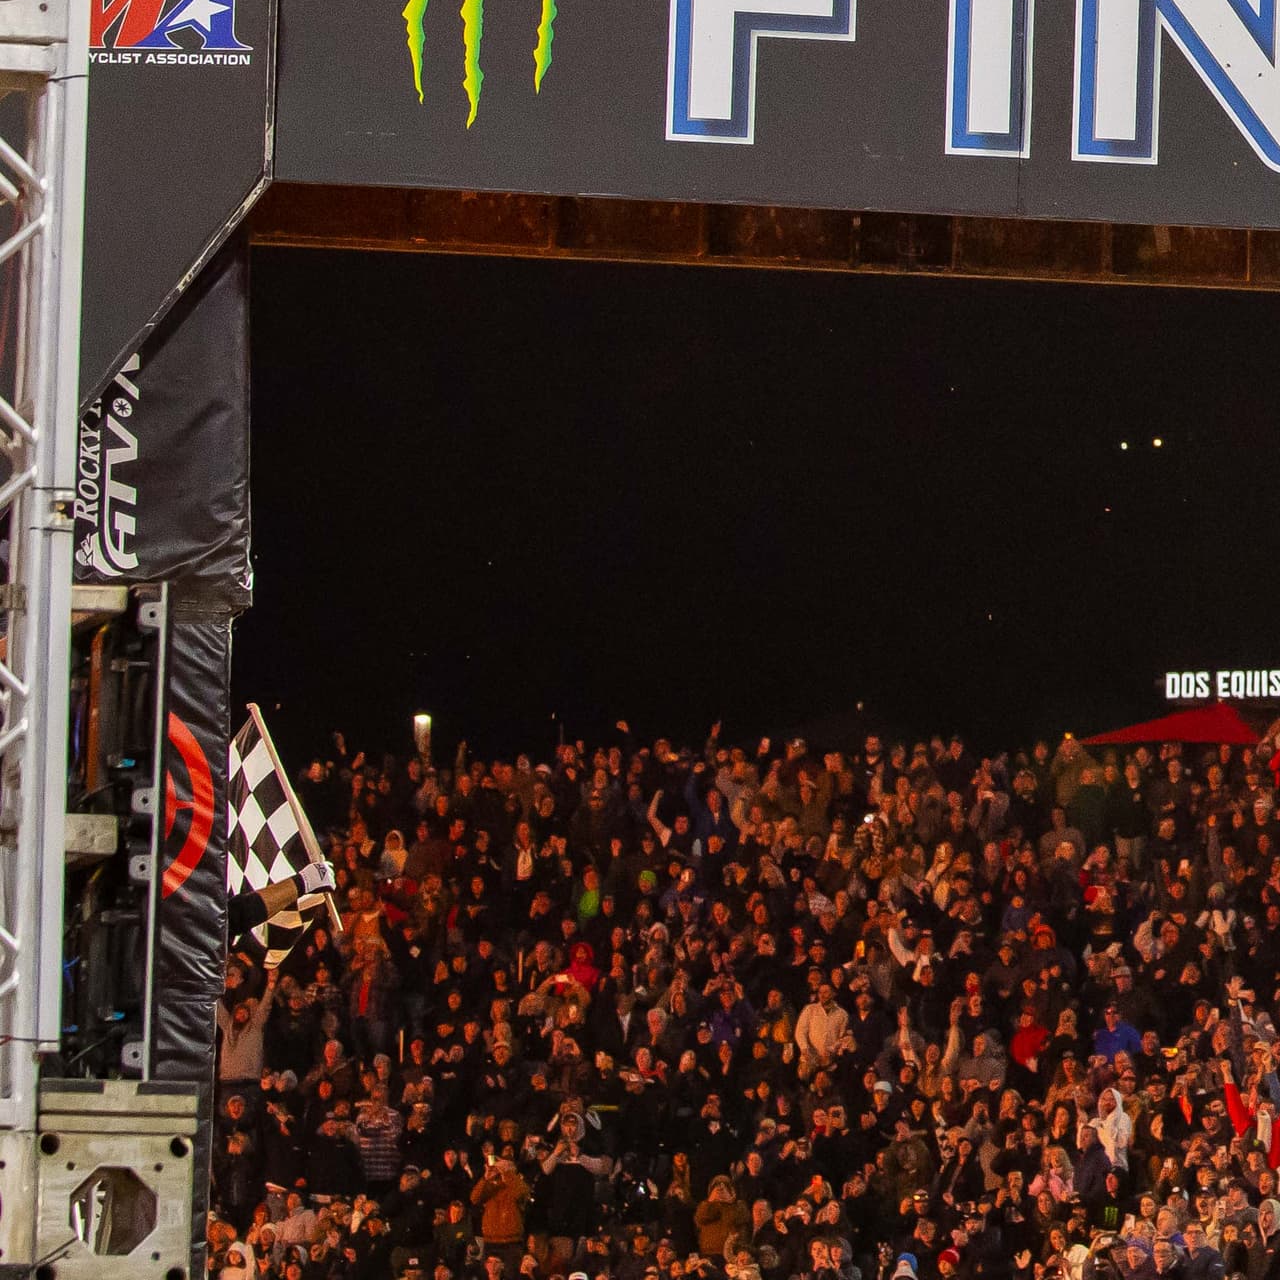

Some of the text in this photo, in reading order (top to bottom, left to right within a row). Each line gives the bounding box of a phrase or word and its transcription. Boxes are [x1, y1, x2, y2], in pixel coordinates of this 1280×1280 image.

[88, 52, 251, 66] YCLIST ASSOCIATION
[73, 419, 102, 527] ROCKY
[1165, 672, 1210, 699] DOS
